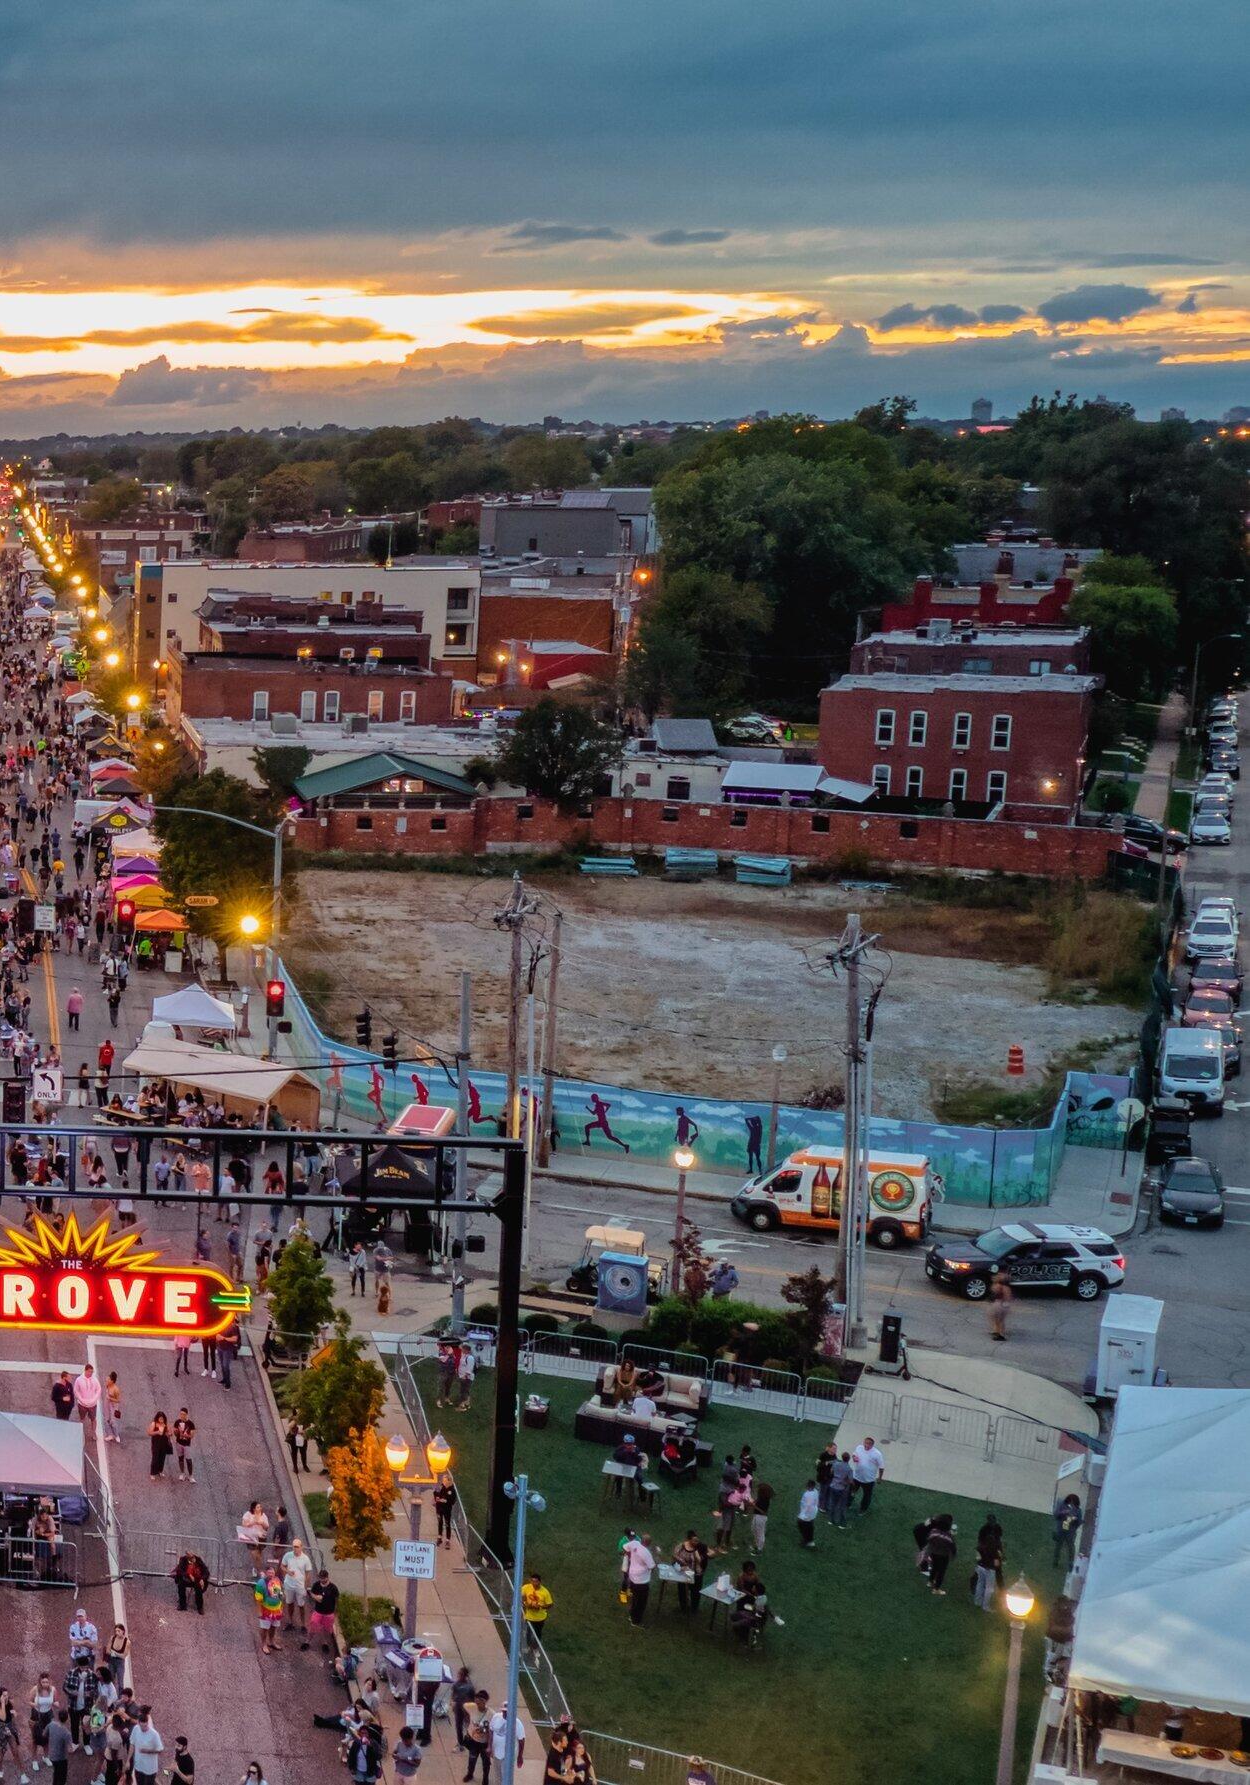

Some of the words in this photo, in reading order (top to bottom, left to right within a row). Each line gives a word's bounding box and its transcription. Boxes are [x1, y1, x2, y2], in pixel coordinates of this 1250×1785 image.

[37, 1091, 58, 1099] ONLY
[373, 1167, 388, 1178] JIM
[389, 1165, 410, 1179] BEAM
[60, 1259, 83, 1270] THE
[1008, 1264, 1071, 1276] POLICE
[404, 1556, 425, 1564] MUST
[415, 1567, 430, 1575] LEFT
